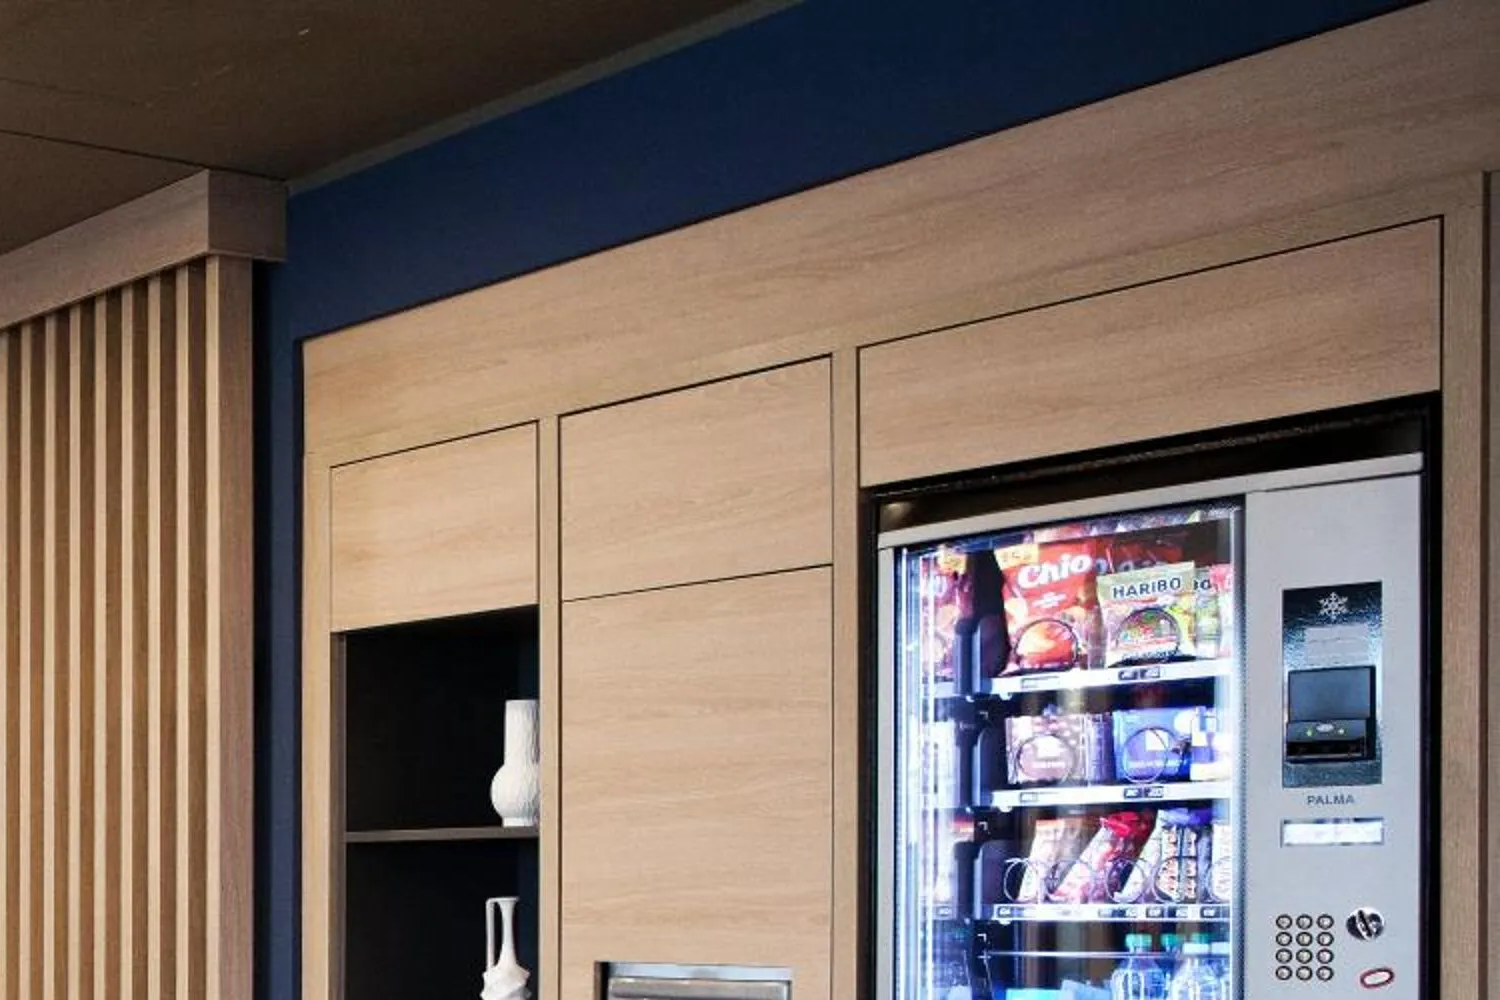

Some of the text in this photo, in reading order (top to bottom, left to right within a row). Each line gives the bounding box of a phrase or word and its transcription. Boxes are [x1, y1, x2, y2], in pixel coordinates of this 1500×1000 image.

[1018, 553, 1093, 589] Chio
[1113, 577, 1181, 599] HARIBO
[1307, 795, 1355, 805] PALMA
